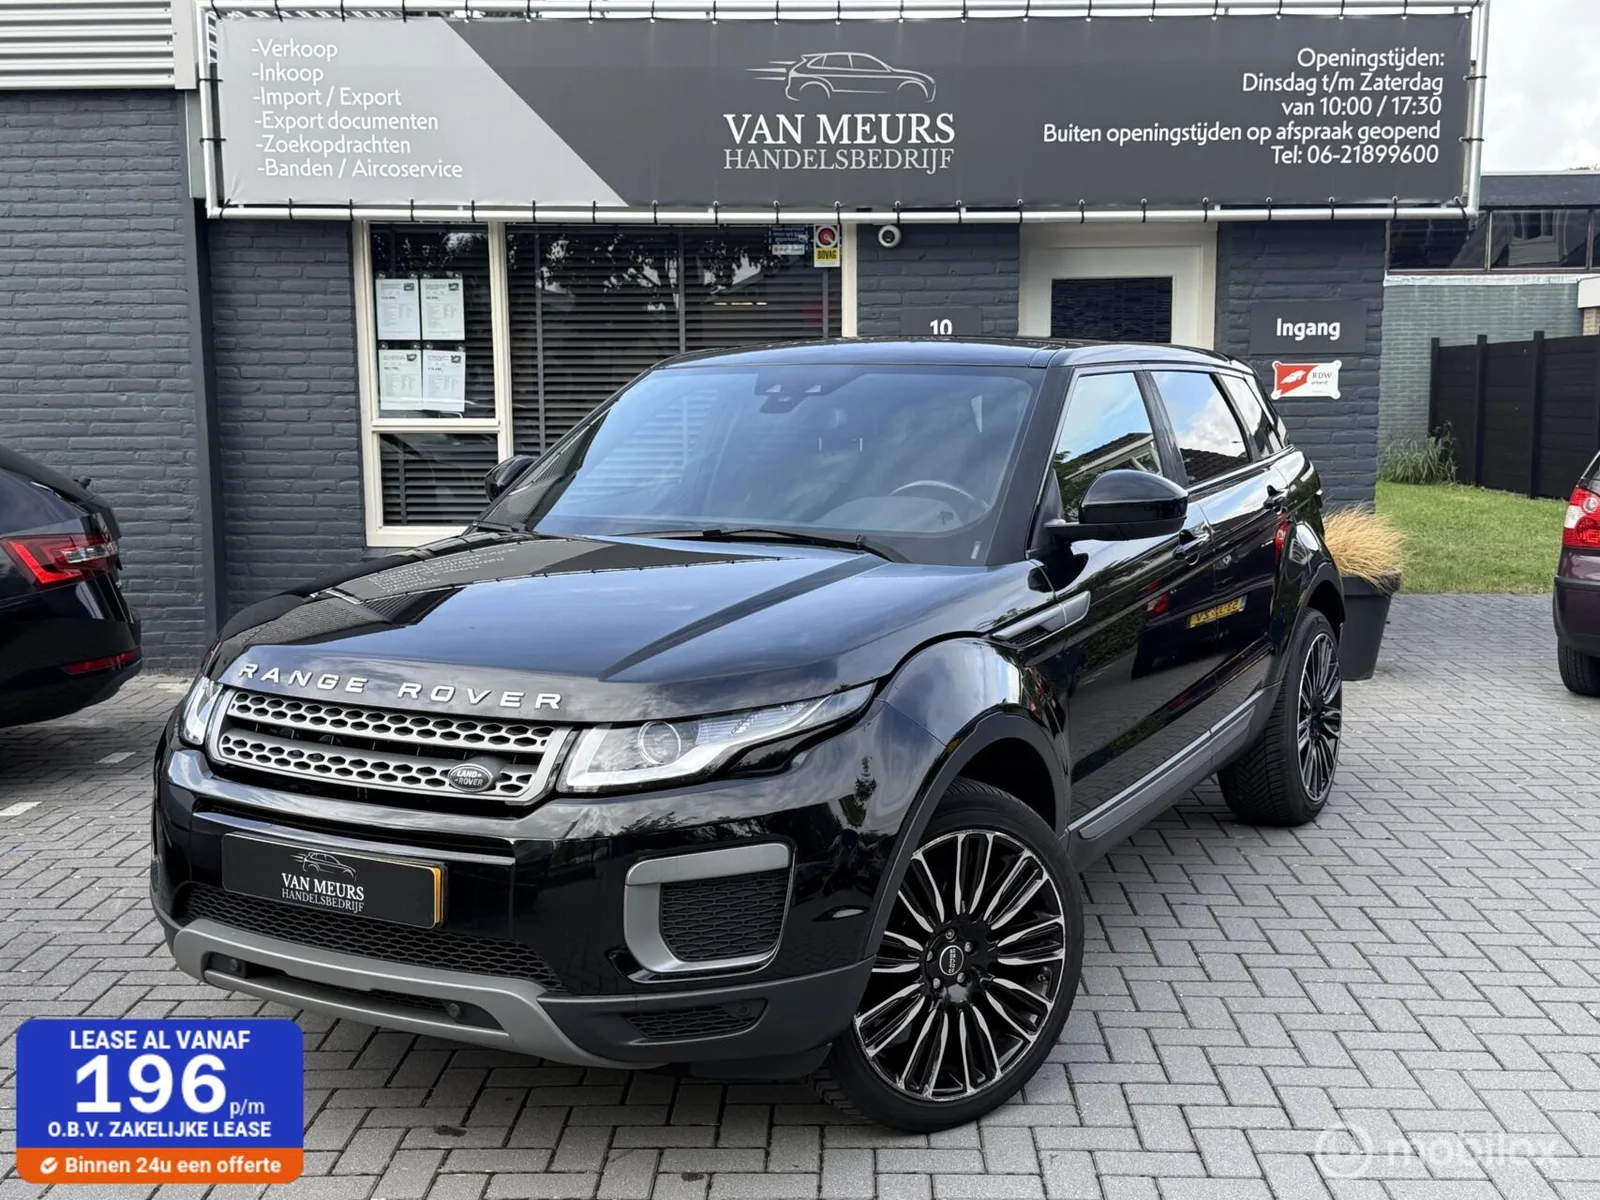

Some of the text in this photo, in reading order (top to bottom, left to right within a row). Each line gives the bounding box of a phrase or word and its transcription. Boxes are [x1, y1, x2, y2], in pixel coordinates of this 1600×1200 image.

[251, 38, 338, 62] -Verkoop
[1297, 48, 1445, 72] Openingstijden:
[252, 62, 324, 85] -Inkoop
[1242, 72, 1443, 96] Dinsdag t/m Zaterdag
[253, 86, 401, 109] -Import / Export
[1282, 97, 1441, 117] van 10:00 / 17:30
[254, 111, 438, 133] -Export documenten
[723, 112, 955, 144] VAN MEURS
[1043, 120, 1440, 147] Buiten openingstijden op afspraak geopend
[255, 135, 411, 156] -Zoekopdrachten
[1271, 144, 1439, 163] Tel: 06-21899600
[257, 158, 463, 179] -Banden / Aircoservice
[723, 148, 954, 174] HANDELSBEDRIJF
[817, 250, 836, 260] BOVAG
[929, 319, 953, 335] 10
[1276, 318, 1341, 341] Ingang
[238, 663, 563, 710] RANGE ROVER
[457, 770, 478, 778] LAND
[458, 777, 483, 786] ROVER
[281, 872, 364, 900] VAN MEURS
[281, 888, 365, 914] HANDELSBEDRIJF
